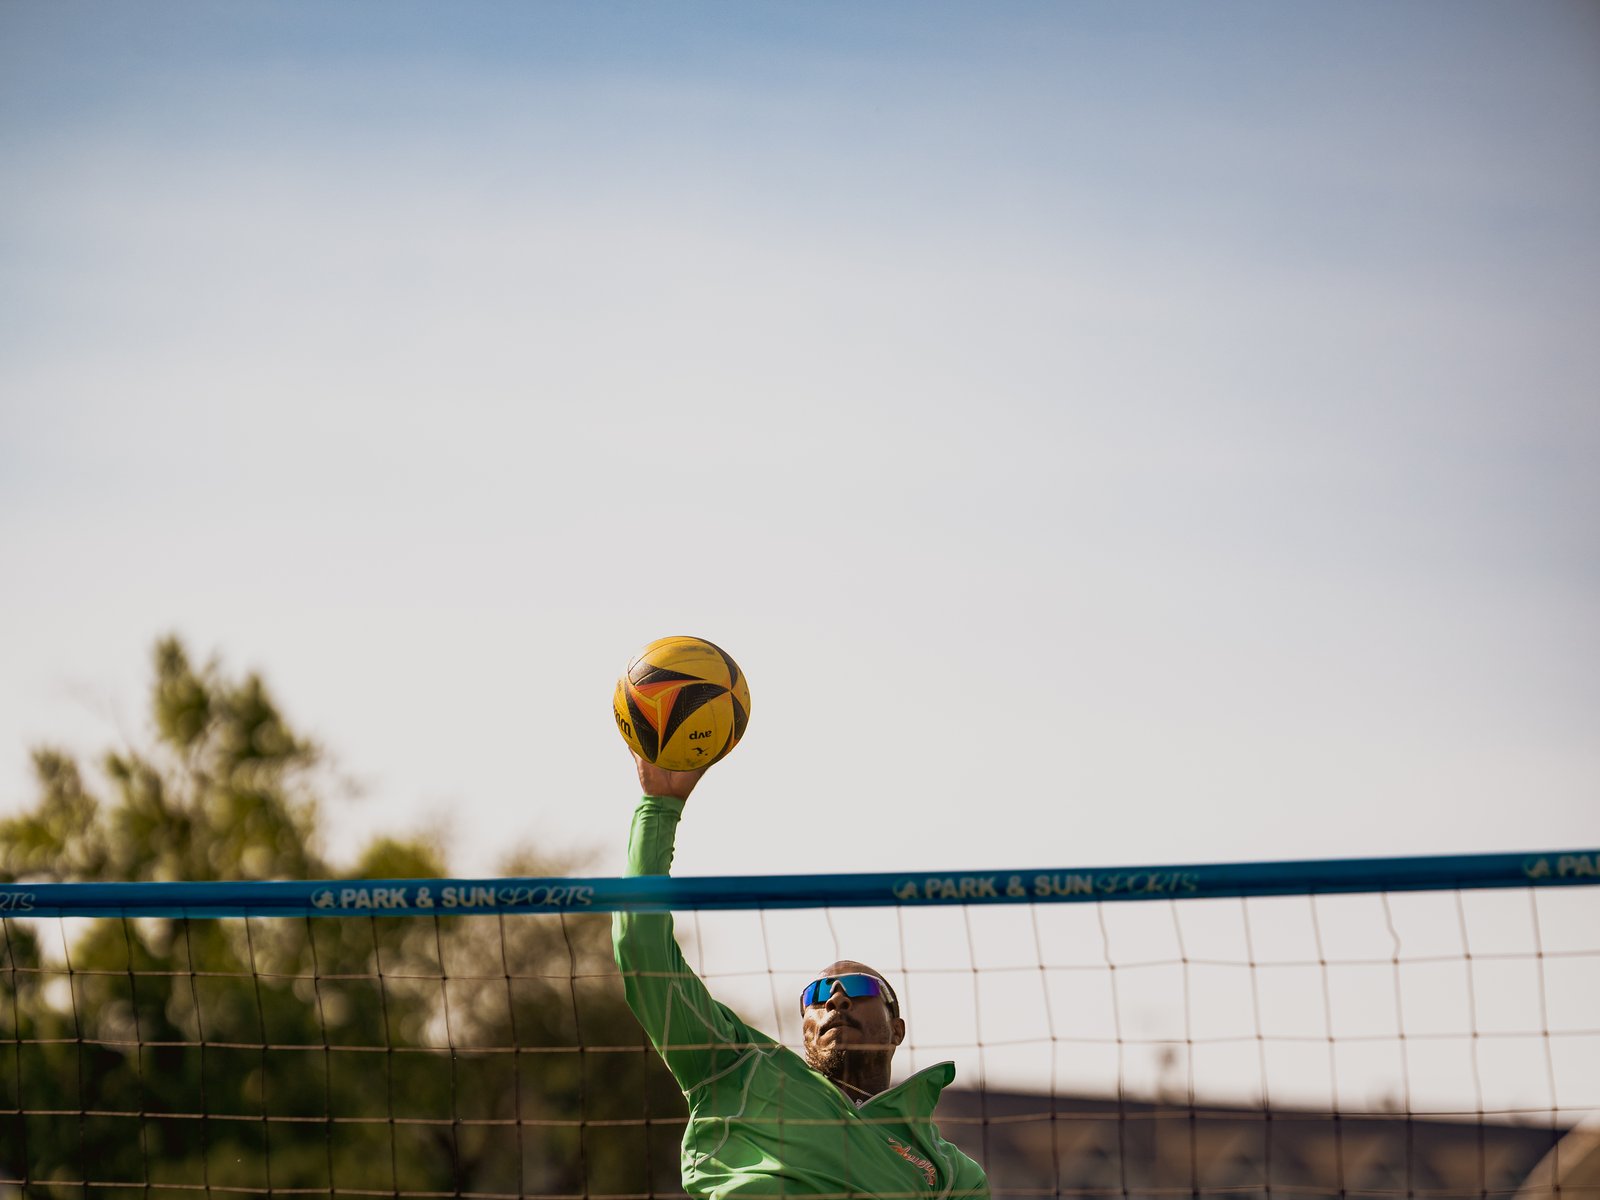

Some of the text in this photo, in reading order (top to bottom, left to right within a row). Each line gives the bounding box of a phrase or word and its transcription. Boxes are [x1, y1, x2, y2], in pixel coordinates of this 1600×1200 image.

[689, 730, 713, 740] avp
[340, 885, 594, 909] PARK & SUN SPORTS
[925, 876, 998, 899] PARK
[1006, 875, 1026, 897] &
[1034, 874, 1092, 896] SUN
